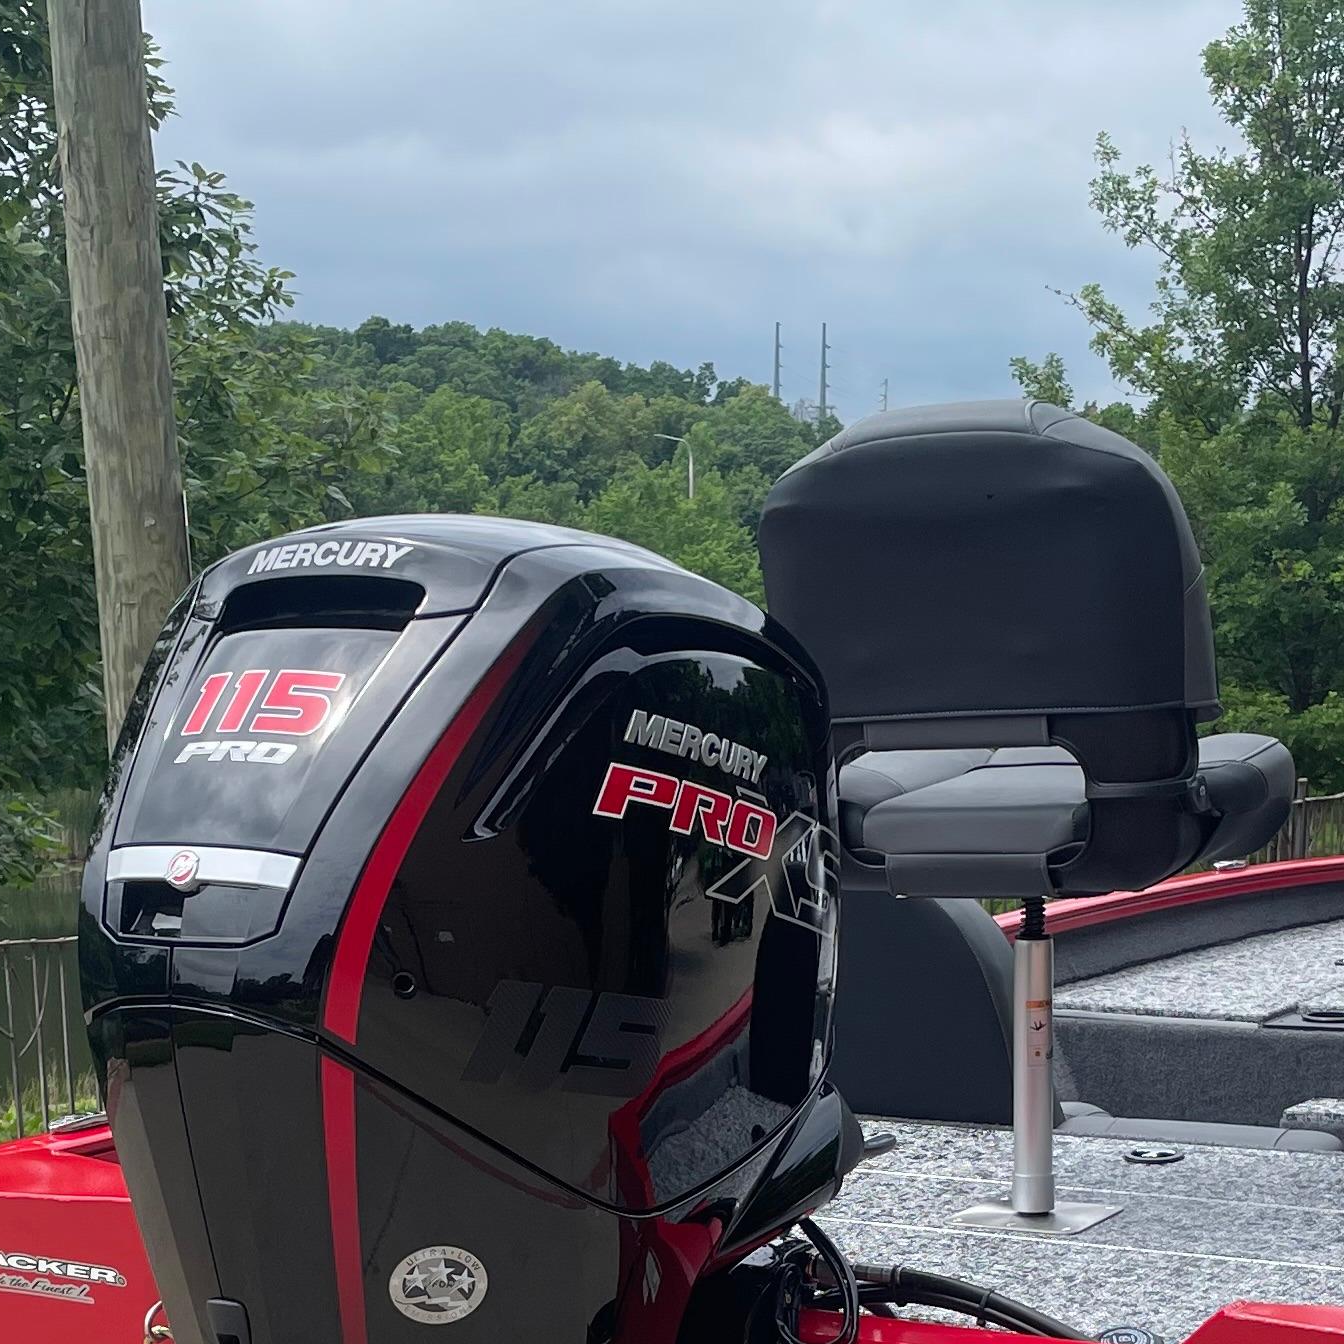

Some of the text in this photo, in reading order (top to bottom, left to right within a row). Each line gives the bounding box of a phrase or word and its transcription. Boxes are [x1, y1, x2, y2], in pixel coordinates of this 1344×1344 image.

[247, 541, 413, 575] MERCURY
[181, 669, 346, 736] 115
[174, 741, 298, 765] PRO
[624, 709, 768, 785] MERCURY
[592, 762, 777, 861] PRO
[460, 979, 673, 1097] 115
[7, 1276, 29, 1289] the
